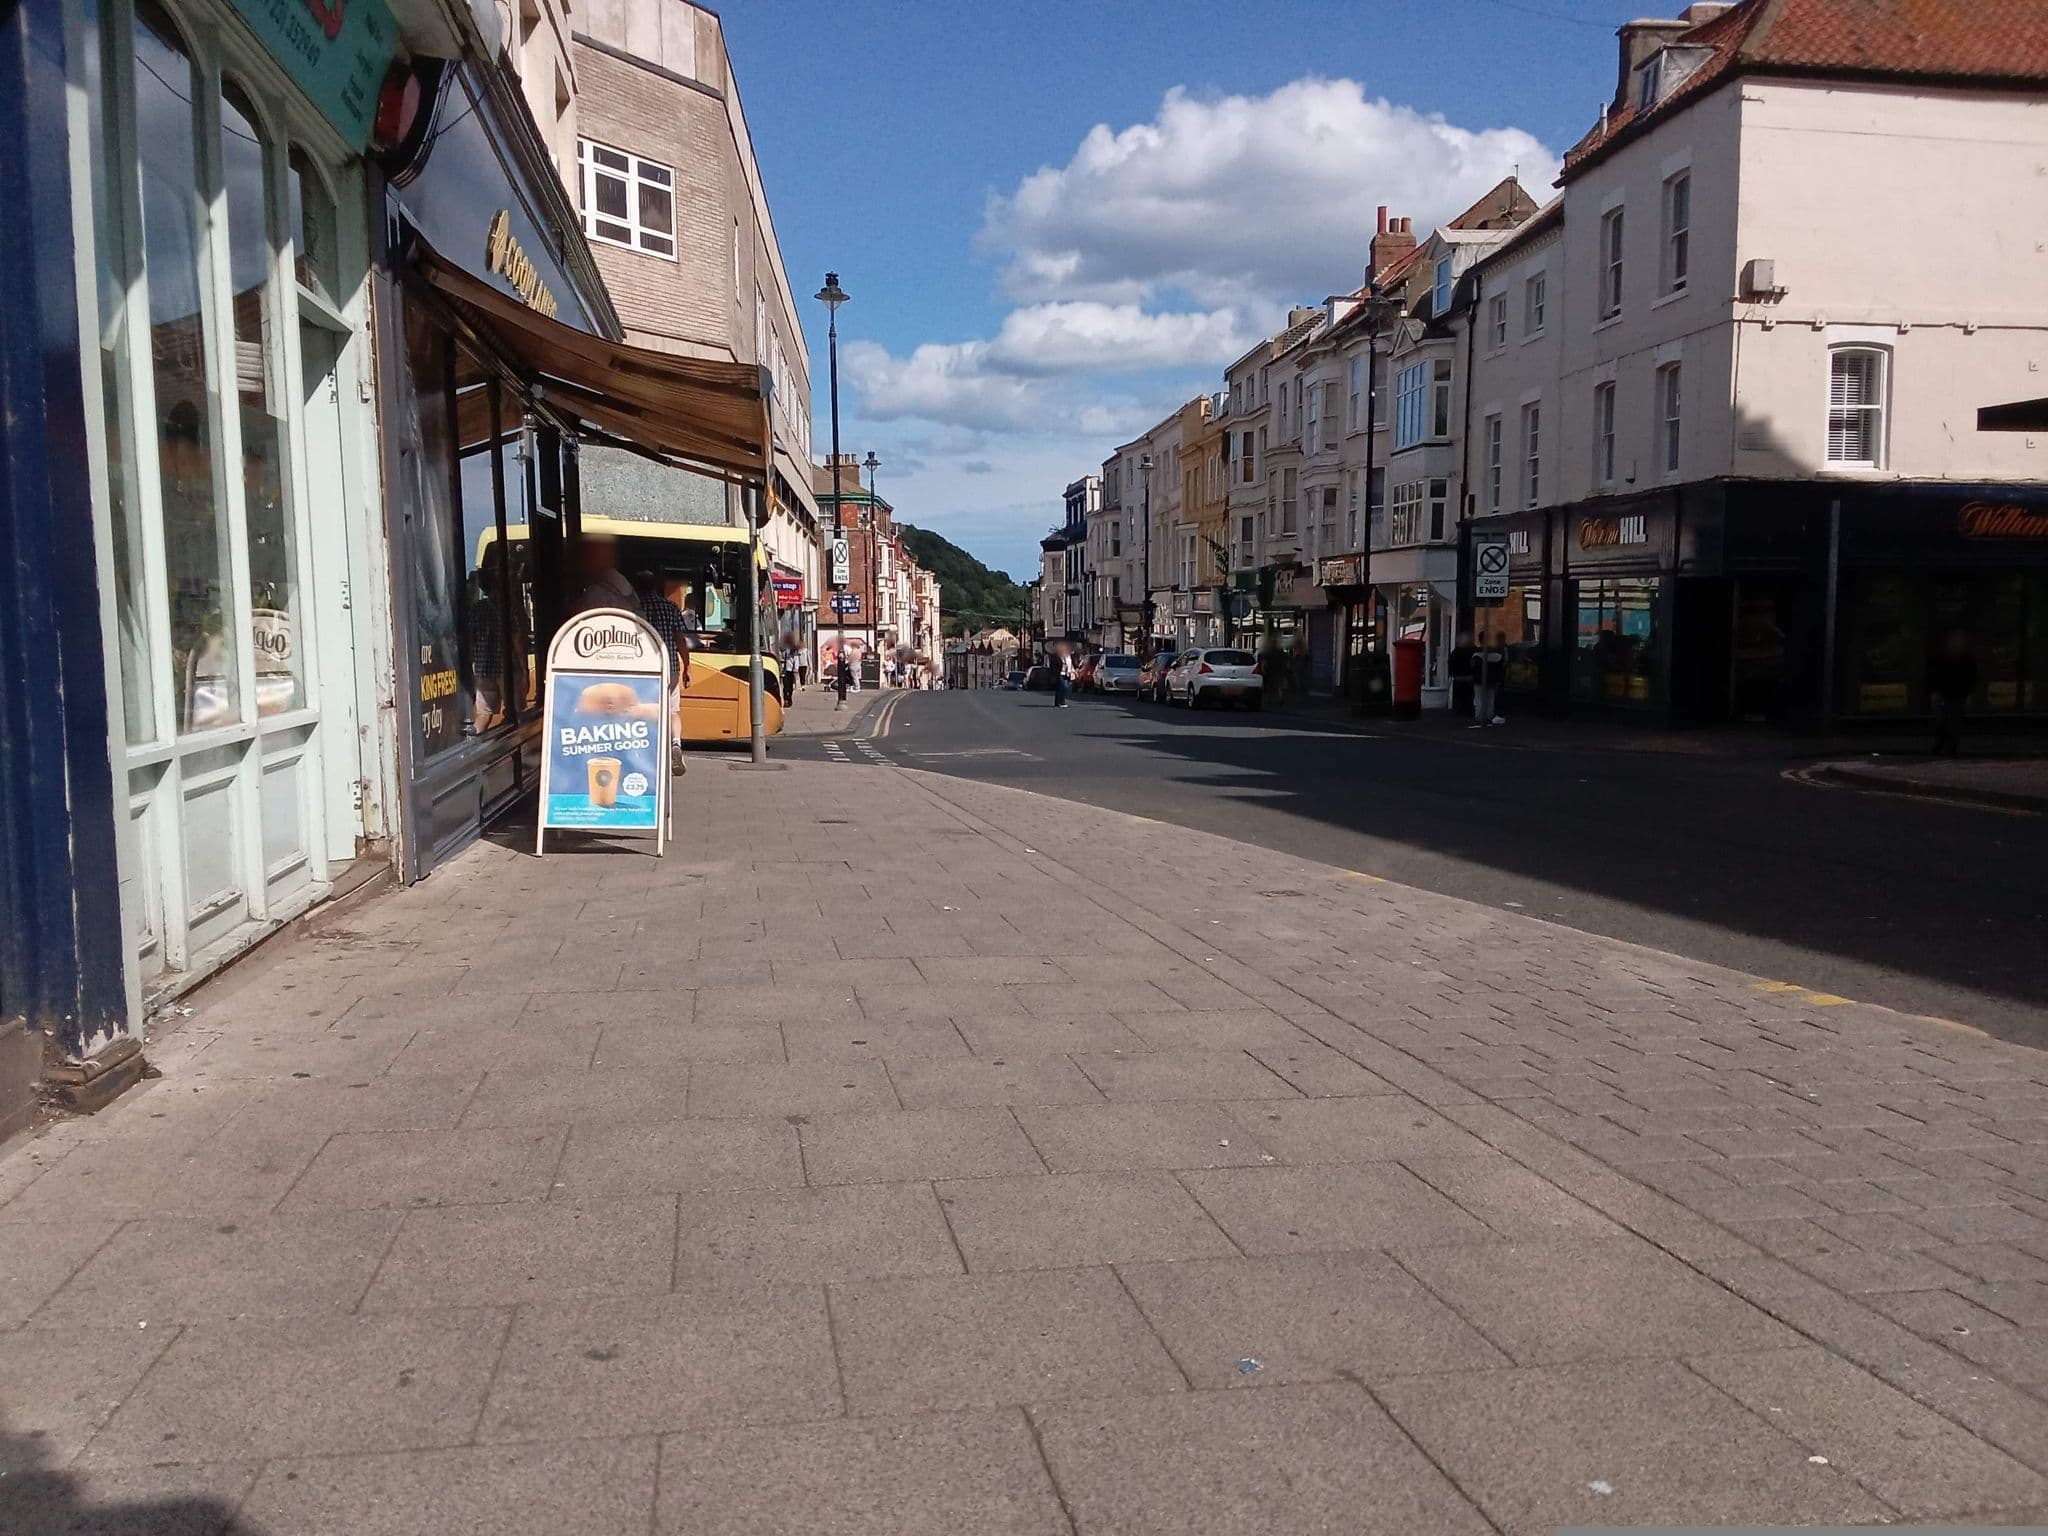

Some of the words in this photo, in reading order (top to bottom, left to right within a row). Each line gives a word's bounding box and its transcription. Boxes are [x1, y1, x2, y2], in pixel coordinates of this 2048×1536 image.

[1509, 530, 1529, 554] HILL
[1619, 515, 1646, 545] HILL
[1479, 586, 1505, 594] ENDS
[573, 624, 644, 658] Cooplands
[437, 669, 457, 697] FRESH
[431, 704, 443, 734] day
[560, 720, 648, 746] BAKING
[562, 742, 612, 756] SUMMER
[614, 738, 650, 751] GOOD
